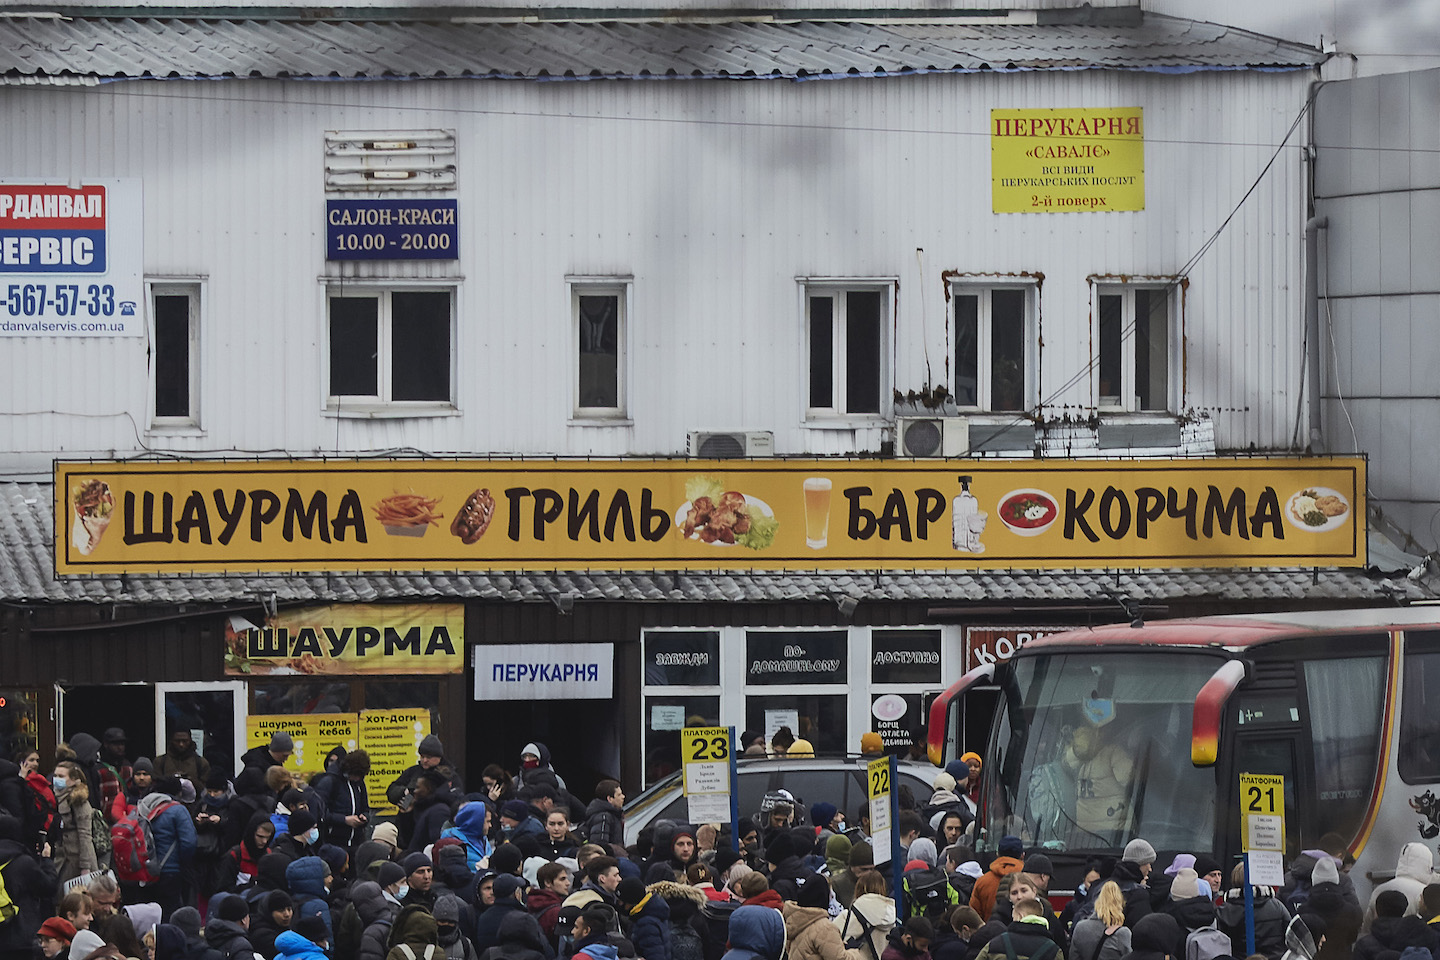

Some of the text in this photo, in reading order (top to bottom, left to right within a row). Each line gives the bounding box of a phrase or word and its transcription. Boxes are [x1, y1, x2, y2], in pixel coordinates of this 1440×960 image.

[995, 117, 1142, 137] ПЕРУКАРНЯ
[1026, 145, 1111, 159] «САВАЛЄ»
[1042, 165, 1094, 175] ВСІ ВИДИ
[1002, 176, 1137, 187] ПЕРУКАРСЬКИХ ПОСЛУГ
[0, 194, 102, 220] РДАНВАЛ
[1031, 195, 1107, 209] 2-й поверх
[329, 208, 455, 226] САЛОН-КРАСИ
[336, 233, 386, 251] 10.00
[401, 232, 450, 250] 20.00
[121, 488, 369, 546] ШАУРМА
[503, 487, 671, 545] ГРИЛЬ
[843, 486, 946, 542] БАР
[1062, 485, 1286, 542] КОРЧМА
[248, 626, 456, 658] ШАУРМА
[784, 645, 806, 657] ПО-
[655, 652, 709, 666] ЗАВЖДИ
[750, 659, 841, 674] ДОМАШНЬОМУ
[873, 650, 940, 665] ДОСТУПНО
[492, 663, 598, 683] ПЕРУКАРНЯ
[263, 728, 308, 739] куцей
[877, 721, 899, 729] БОРЩ
[691, 737, 728, 760] 23
[881, 737, 913, 746] ДБИВНА
[872, 769, 889, 796] 22
[1241, 777, 1282, 785] ПЛАТФОРМА
[1248, 786, 1275, 812] 21
